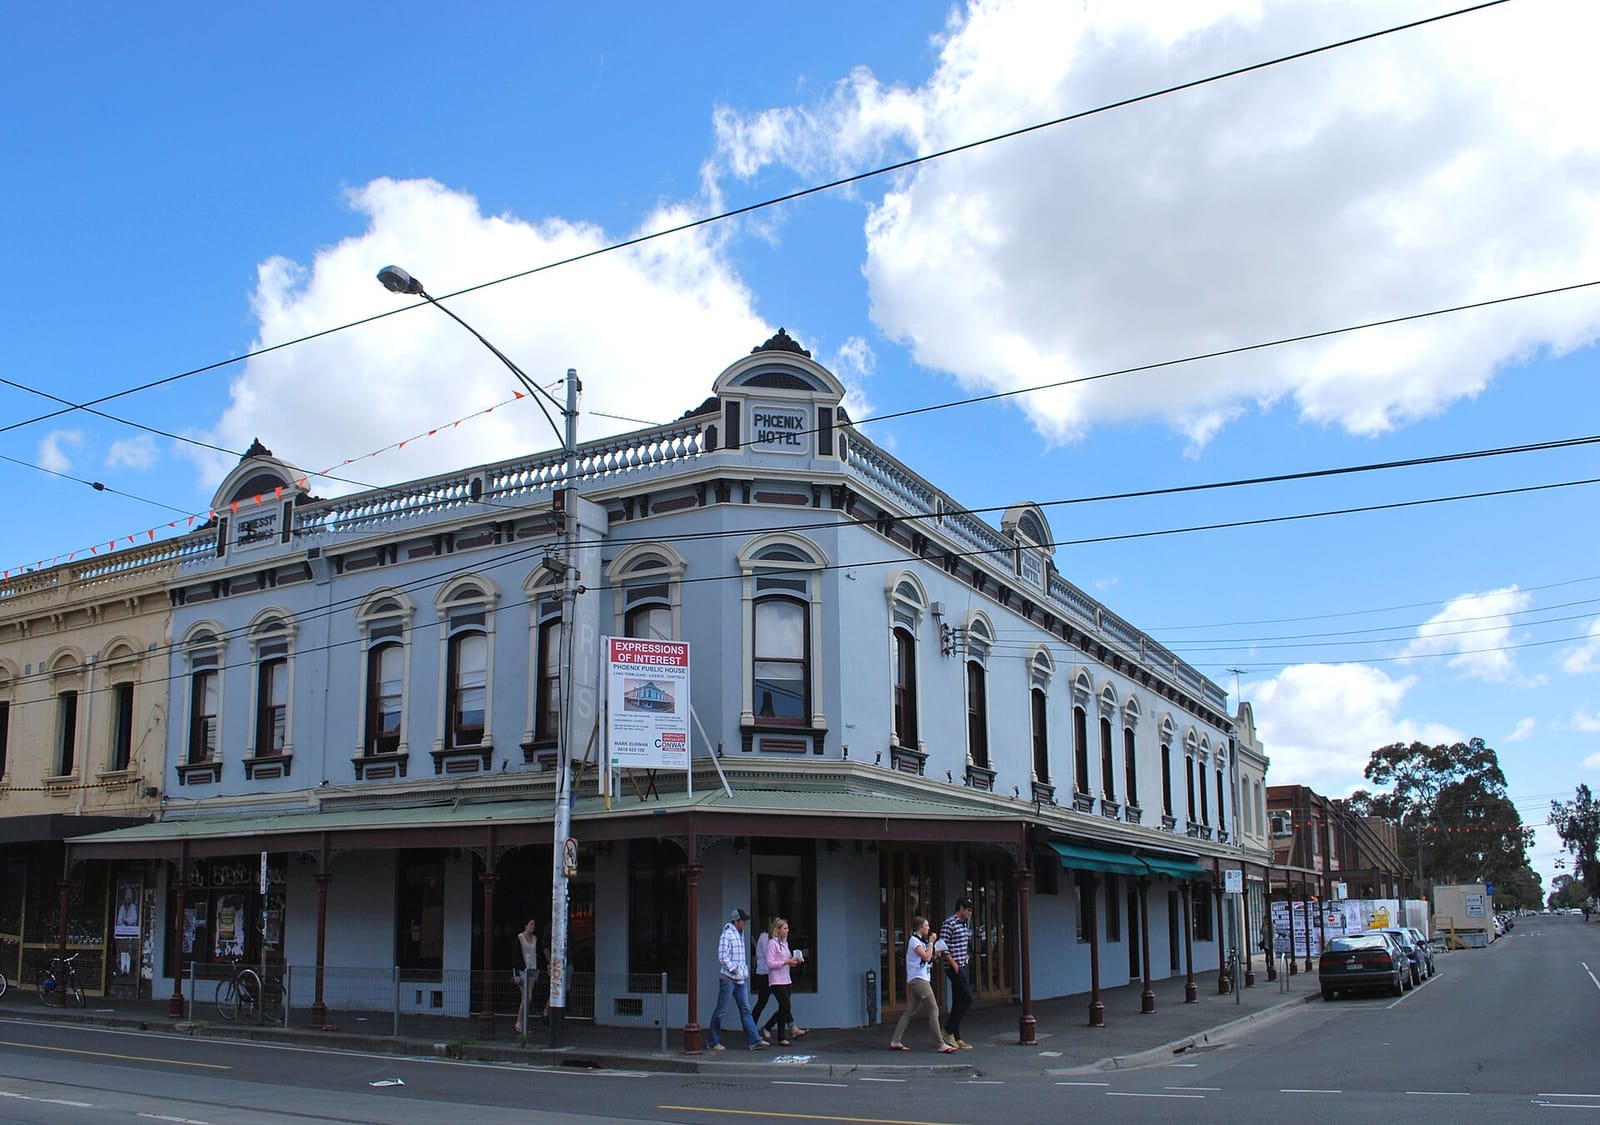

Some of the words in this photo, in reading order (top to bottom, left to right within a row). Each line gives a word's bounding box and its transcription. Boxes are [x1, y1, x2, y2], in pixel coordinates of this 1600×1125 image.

[758, 429, 801, 446] HOTEL
[615, 642, 685, 654] EXPRESSIONS
[618, 653, 632, 662] OF
[634, 655, 682, 665] INTEREST
